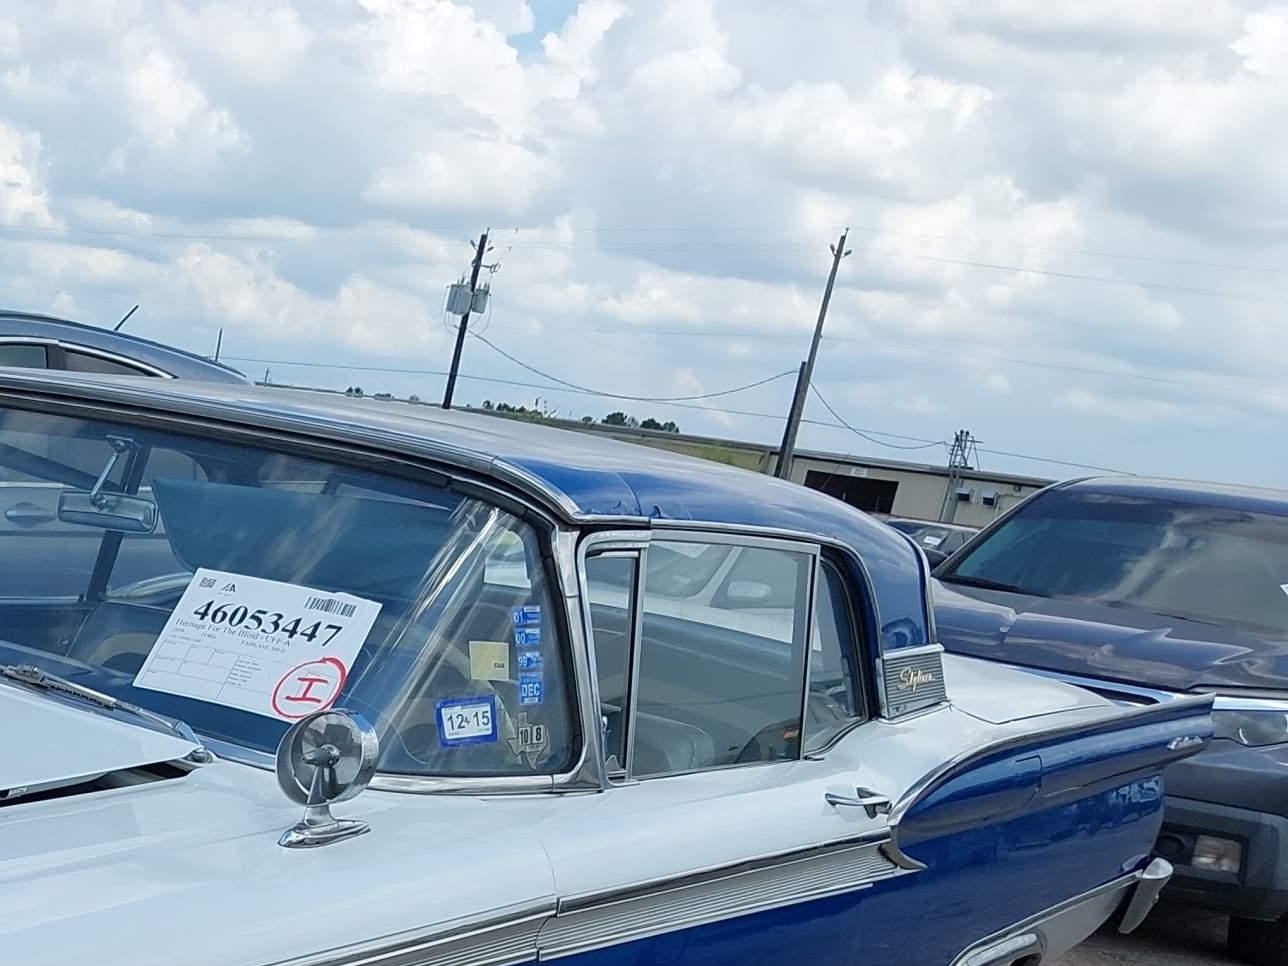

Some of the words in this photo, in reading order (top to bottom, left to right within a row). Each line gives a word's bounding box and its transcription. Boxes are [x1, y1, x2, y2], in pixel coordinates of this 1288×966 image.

[193, 599, 343, 647] 46053447
[223, 626, 237, 634] The
[521, 684, 540, 697] DEC
[446, 713, 466, 731] 12
[472, 710, 490, 727] 15
[519, 728, 529, 745] 10
